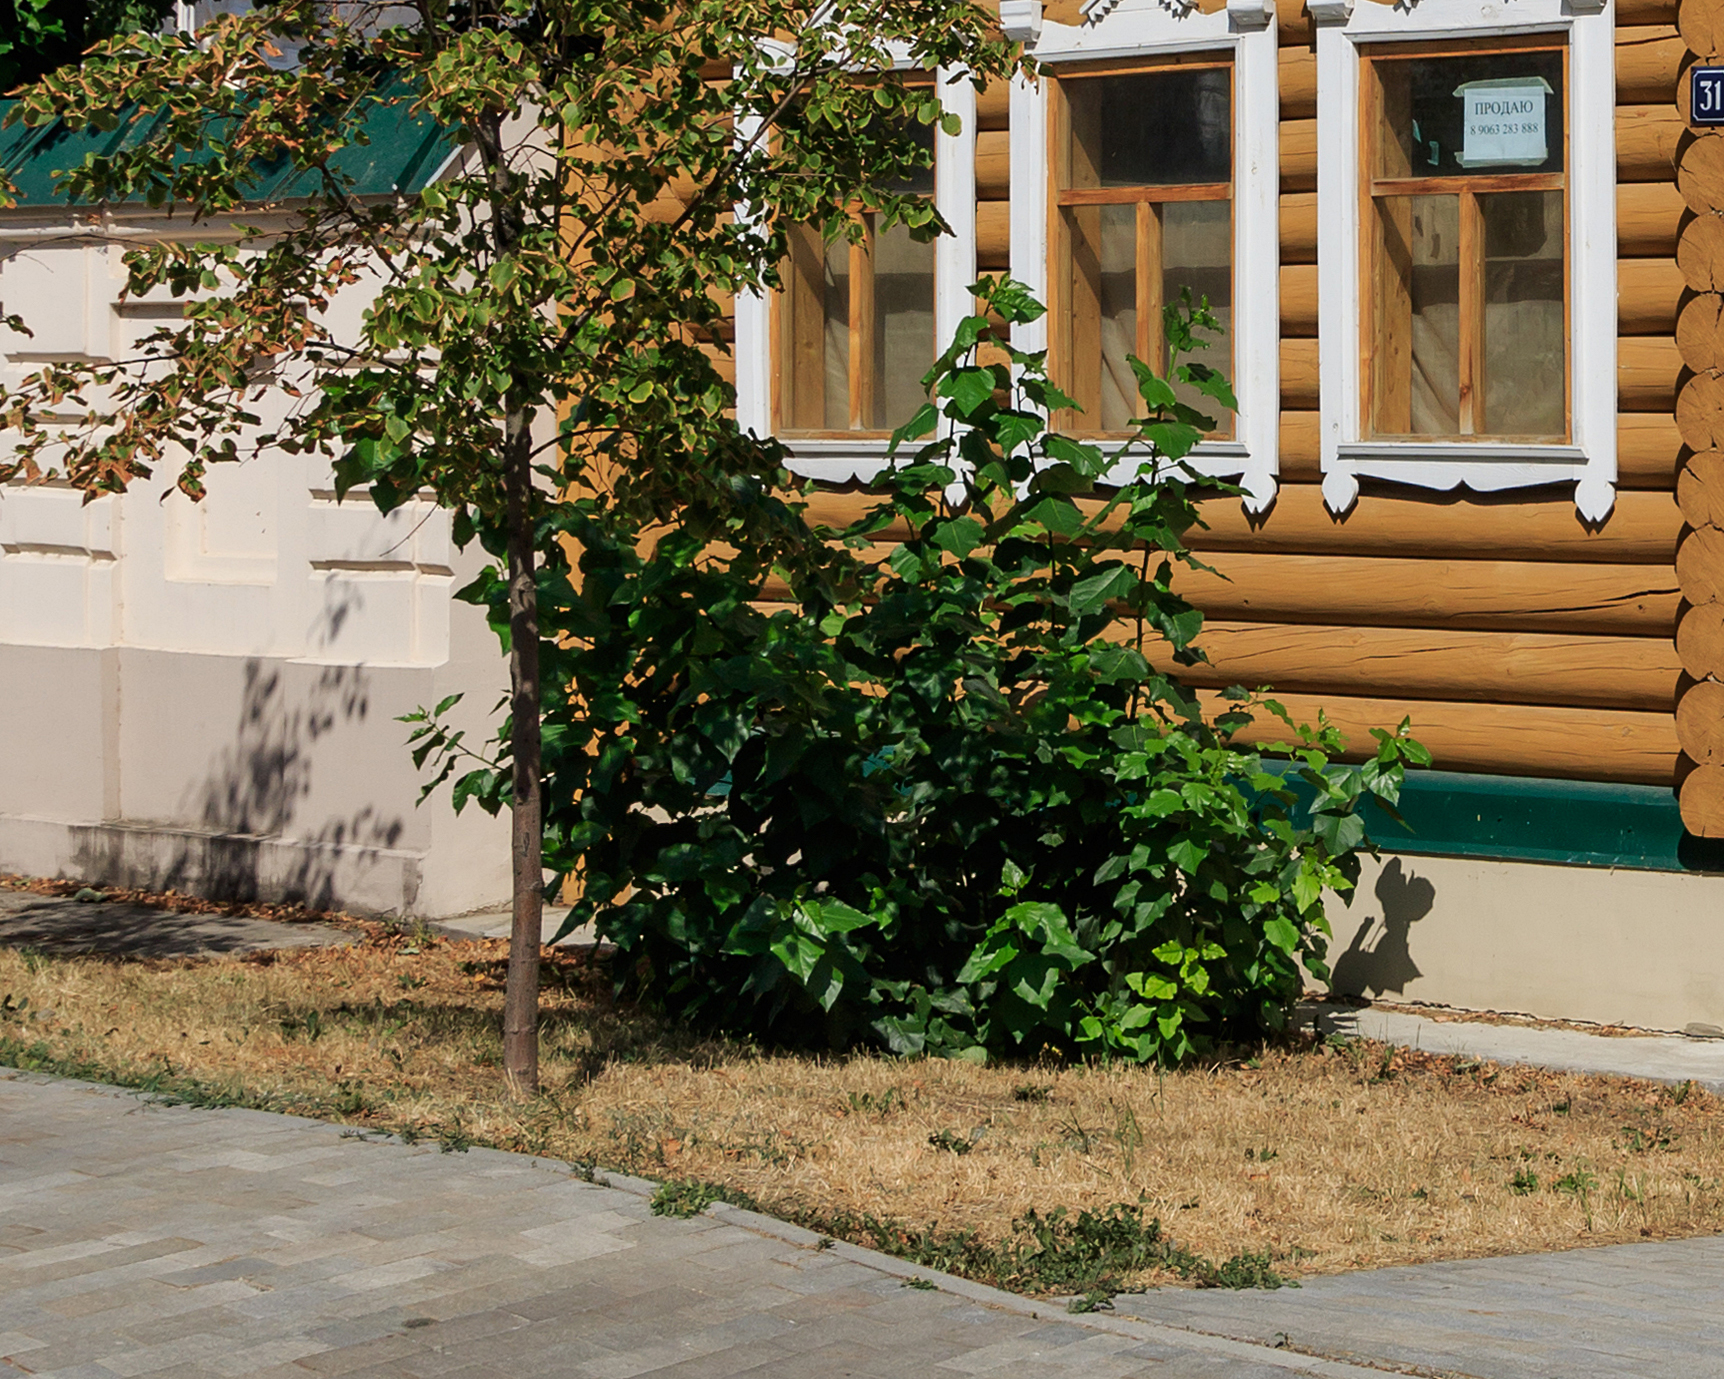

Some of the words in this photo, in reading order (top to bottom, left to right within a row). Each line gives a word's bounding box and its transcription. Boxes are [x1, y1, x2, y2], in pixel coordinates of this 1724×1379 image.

[1699, 80, 1721, 111] 31
[1475, 100, 1533, 116] ПРОДАЮ
[1470, 125, 1476, 135] 8
[1478, 123, 1500, 135] 9063
[1502, 123, 1518, 135] 283
[1521, 122, 1539, 134] 888
